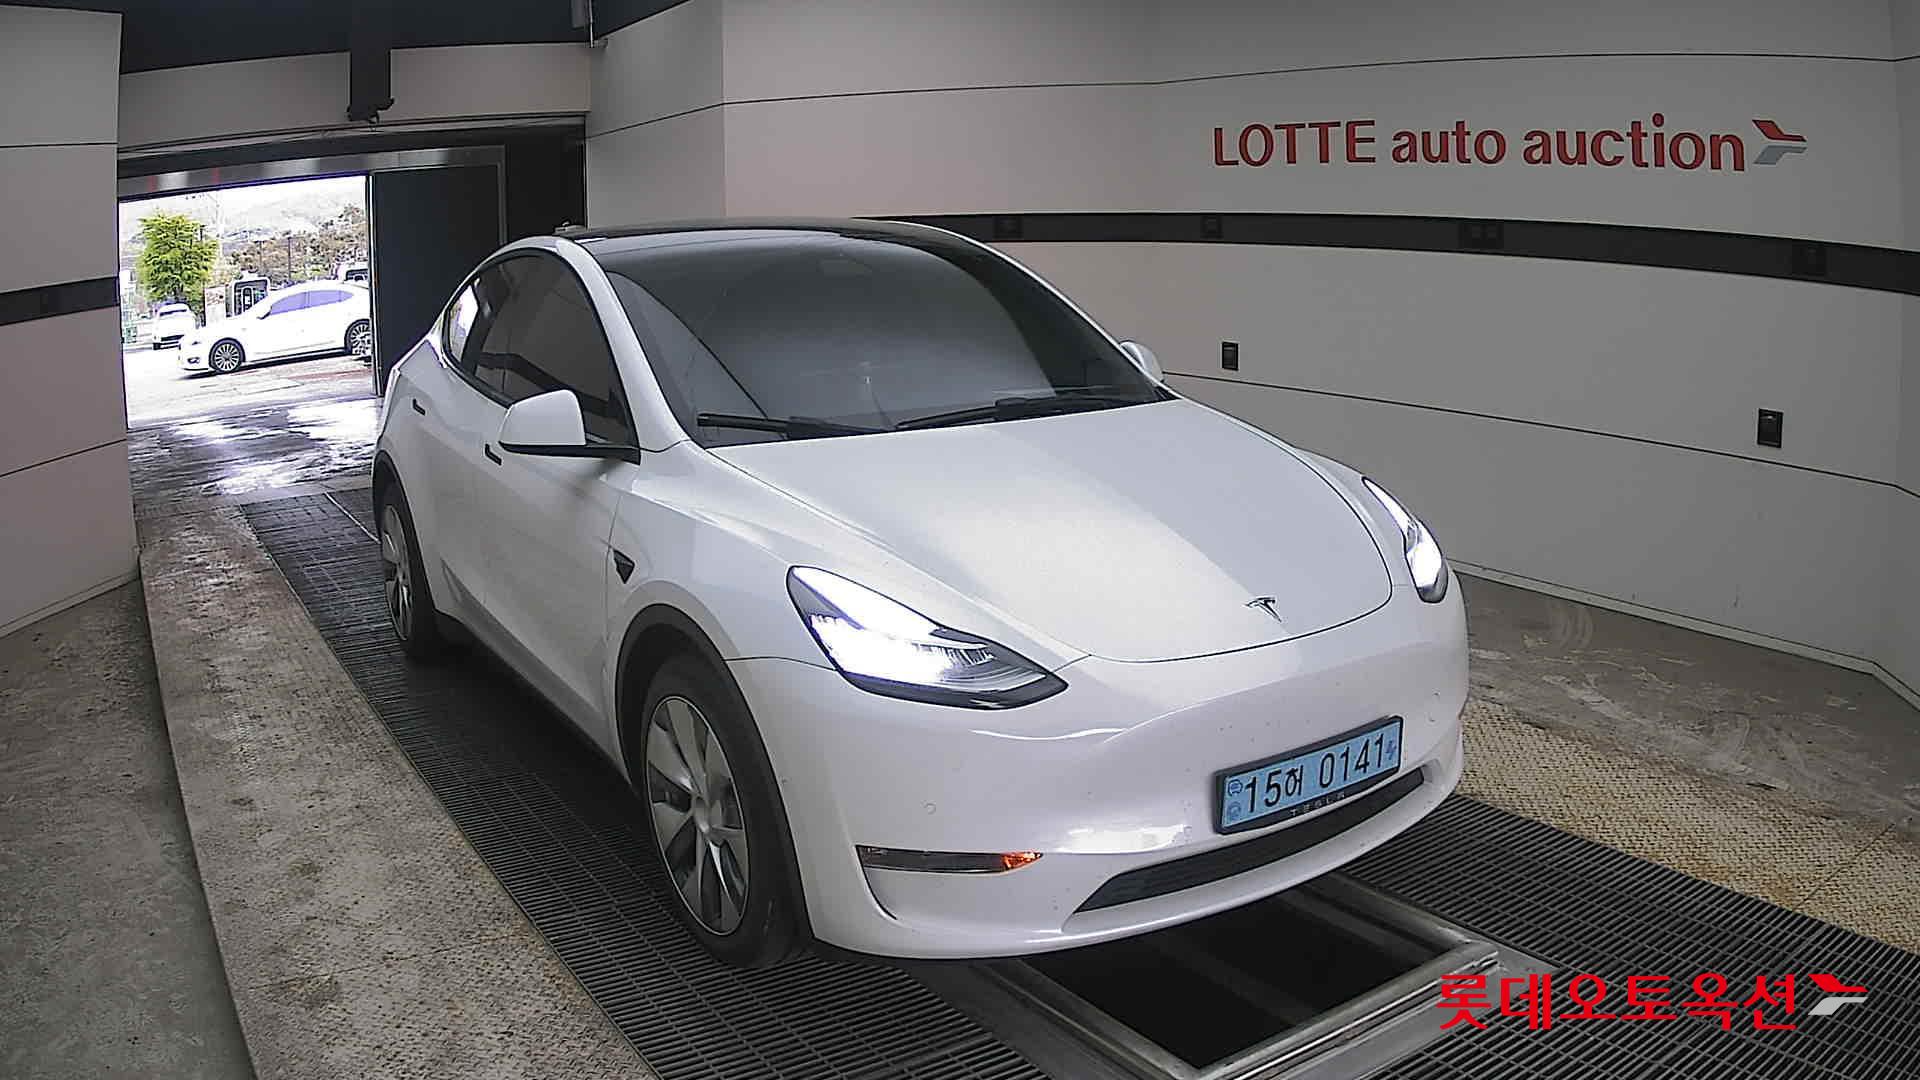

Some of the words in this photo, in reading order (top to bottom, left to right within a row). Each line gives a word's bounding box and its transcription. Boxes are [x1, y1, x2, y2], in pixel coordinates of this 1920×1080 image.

[1213, 120, 1376, 167] LOTTE
[1391, 119, 1507, 165] auto
[1522, 112, 1745, 172] auction
[1245, 764, 1304, 813] 15허
[1319, 733, 1385, 789] 0141
